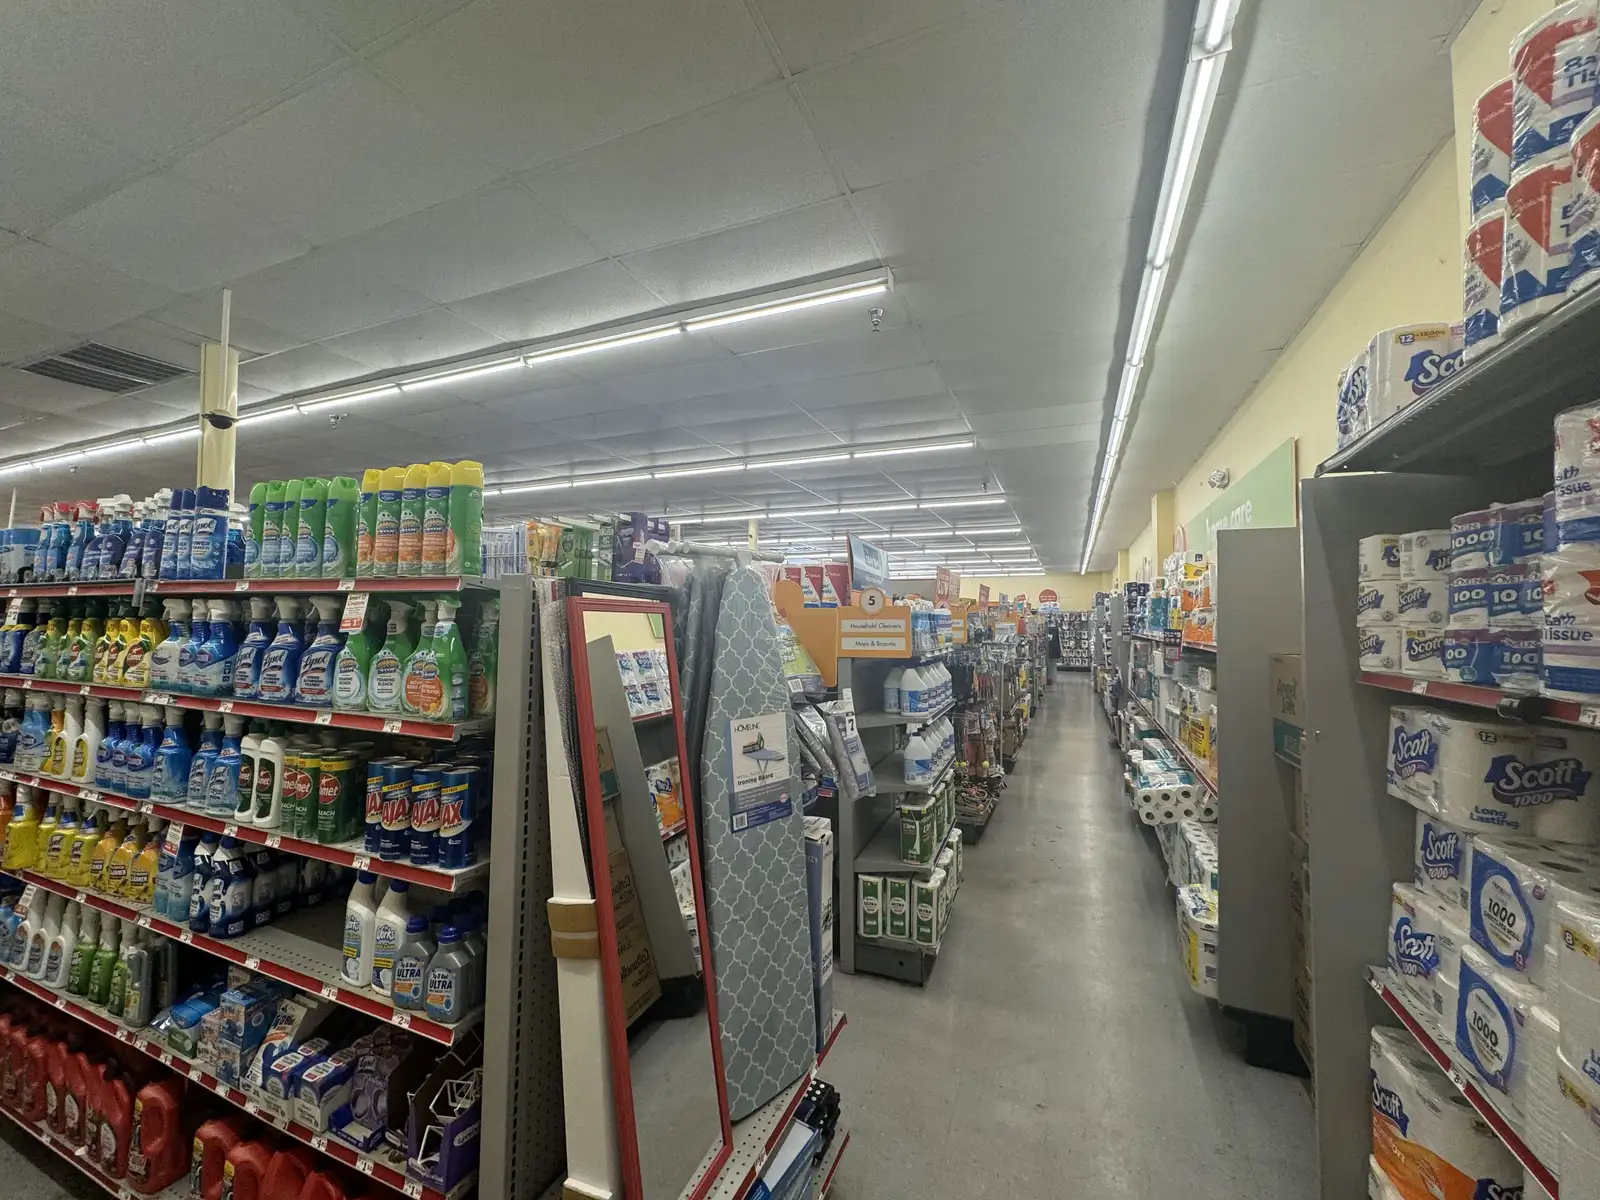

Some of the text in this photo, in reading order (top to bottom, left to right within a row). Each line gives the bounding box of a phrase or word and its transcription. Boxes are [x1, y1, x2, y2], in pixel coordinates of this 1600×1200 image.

[1400, 334, 1416, 344] 12
[1418, 355, 1465, 384] Sco
[868, 596, 876, 606] 5
[264, 652, 284, 666] Lysol
[302, 652, 328, 669] Lysol
[734, 722, 760, 733] HOMELINE
[1479, 731, 1496, 742] 12
[1397, 730, 1430, 761] Scott
[738, 773, 774, 786] Ironing Board
[1499, 760, 1577, 790] Scott
[1514, 792, 1554, 808] 1000
[382, 797, 410, 826] AJA
[1475, 806, 1508, 819] Long
[1470, 812, 1520, 829] Lasting
[1427, 830, 1459, 860] Scott
[1429, 867, 1449, 879] 1000
[1488, 898, 1517, 928] 1000
[1398, 924, 1436, 960] Scott
[396, 968, 421, 978] ULTRA
[429, 979, 453, 990] ULTRA
[1472, 1010, 1499, 1047] 1000
[1372, 1079, 1401, 1119] Scott
